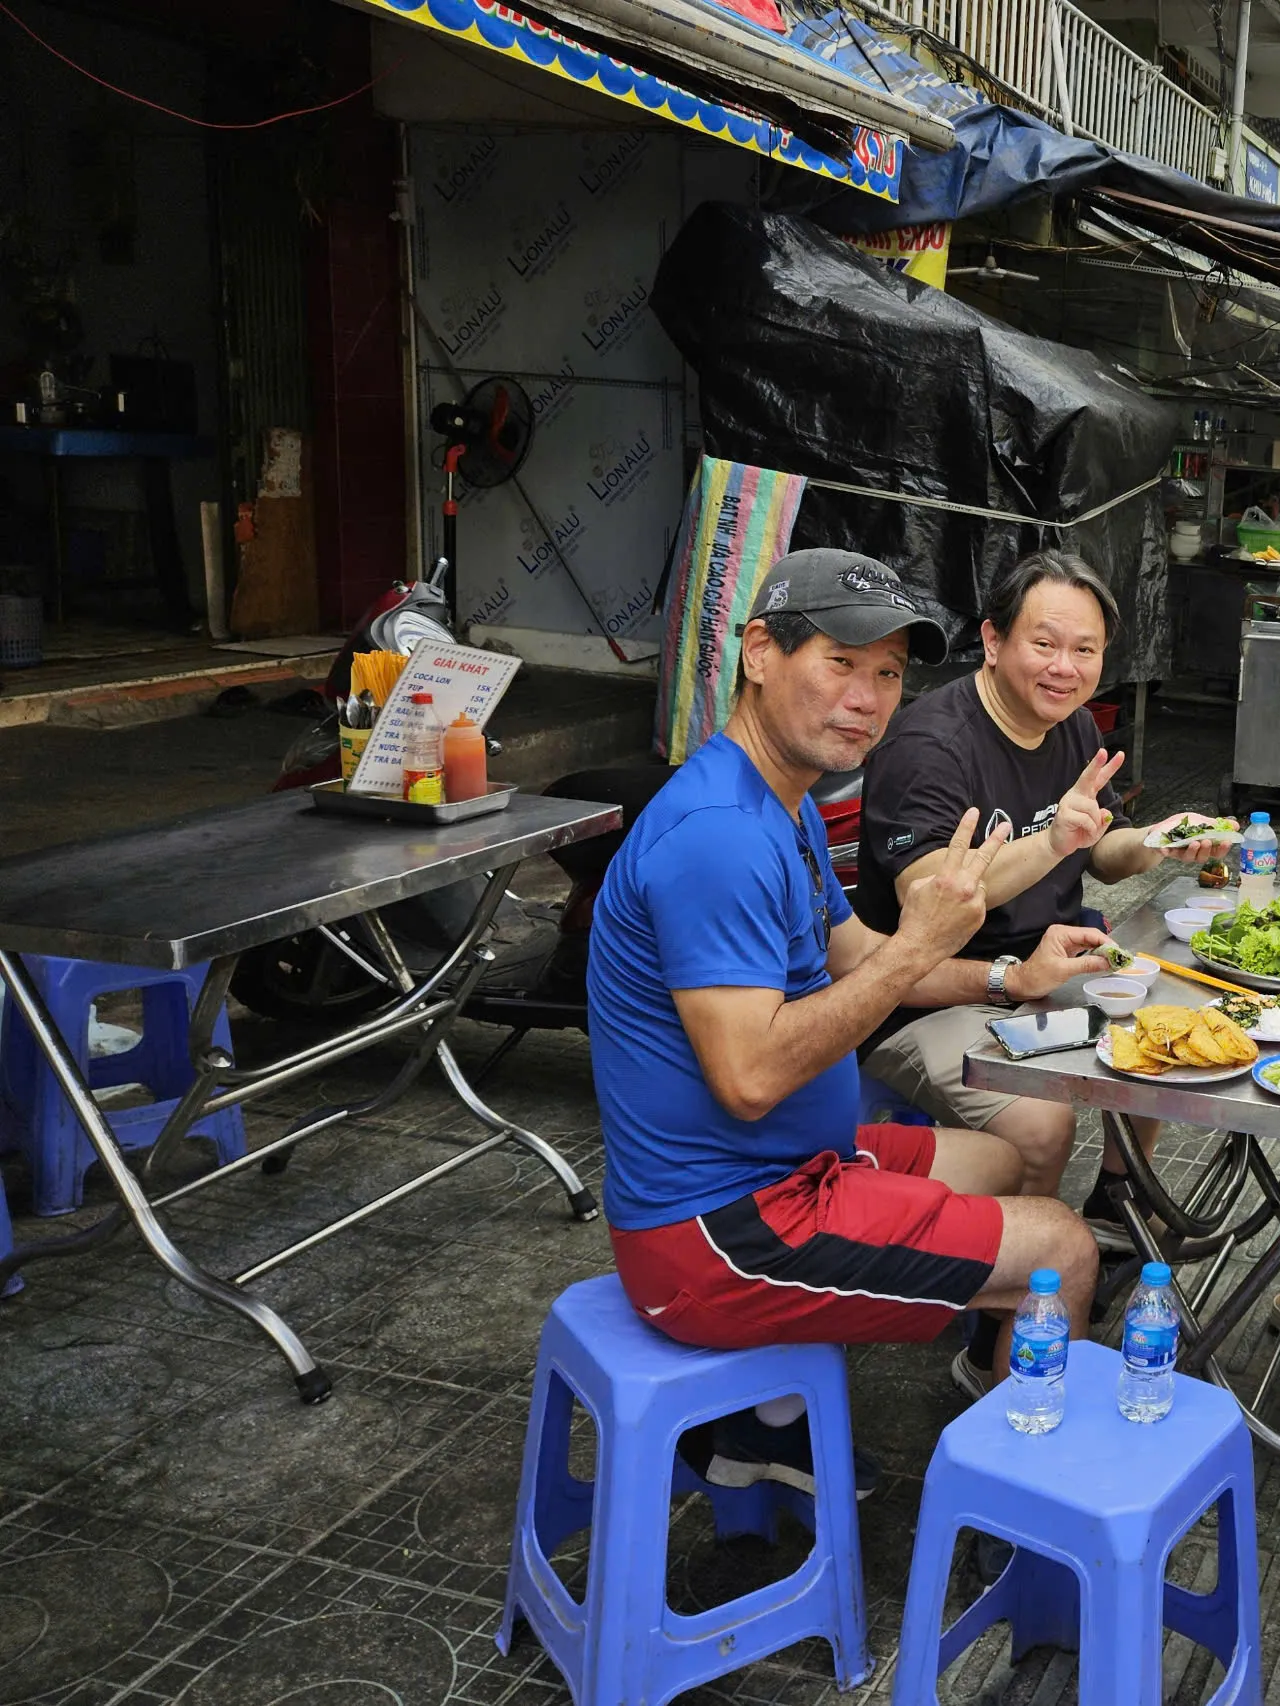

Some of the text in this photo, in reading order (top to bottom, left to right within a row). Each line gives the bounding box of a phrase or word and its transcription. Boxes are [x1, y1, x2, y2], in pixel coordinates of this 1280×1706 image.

[587, 437, 651, 501] LIONALU
[705, 560, 728, 588] CAO
[413, 673, 452, 685] COCA LON
[407, 683, 424, 692] 7UP
[476, 684, 492, 692] 15K
[470, 695, 485, 704] 15K
[464, 706, 480, 715] 15K
